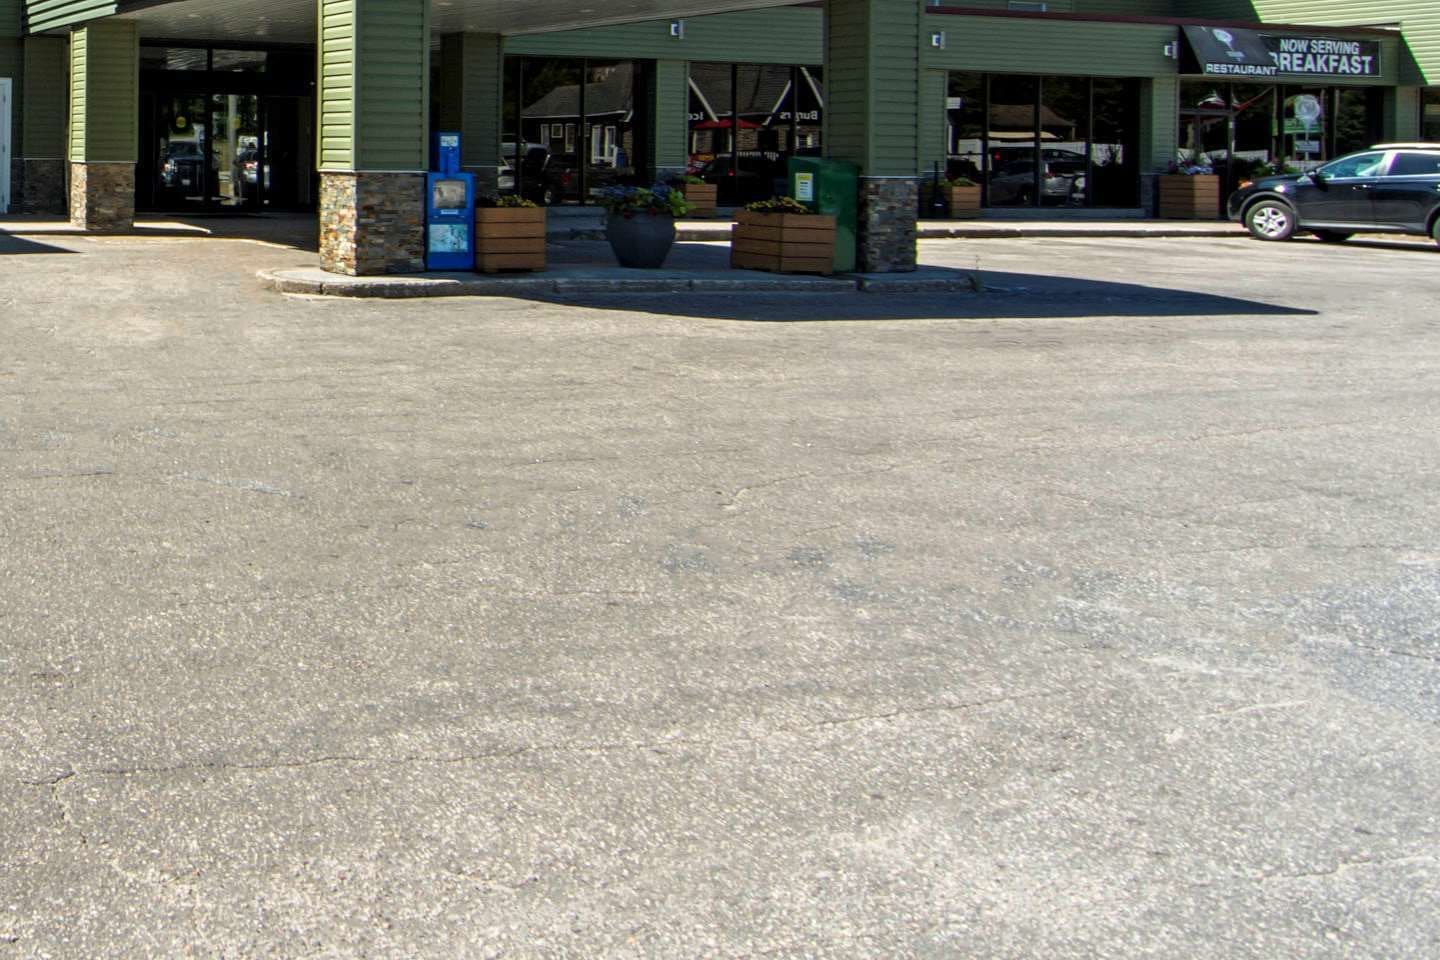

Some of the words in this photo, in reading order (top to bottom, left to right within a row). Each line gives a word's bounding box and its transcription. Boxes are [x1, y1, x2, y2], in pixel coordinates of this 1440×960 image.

[1280, 39, 1309, 54] NOW
[1311, 40, 1360, 55] SERVING
[1206, 63, 1279, 76] RESTAURANT
